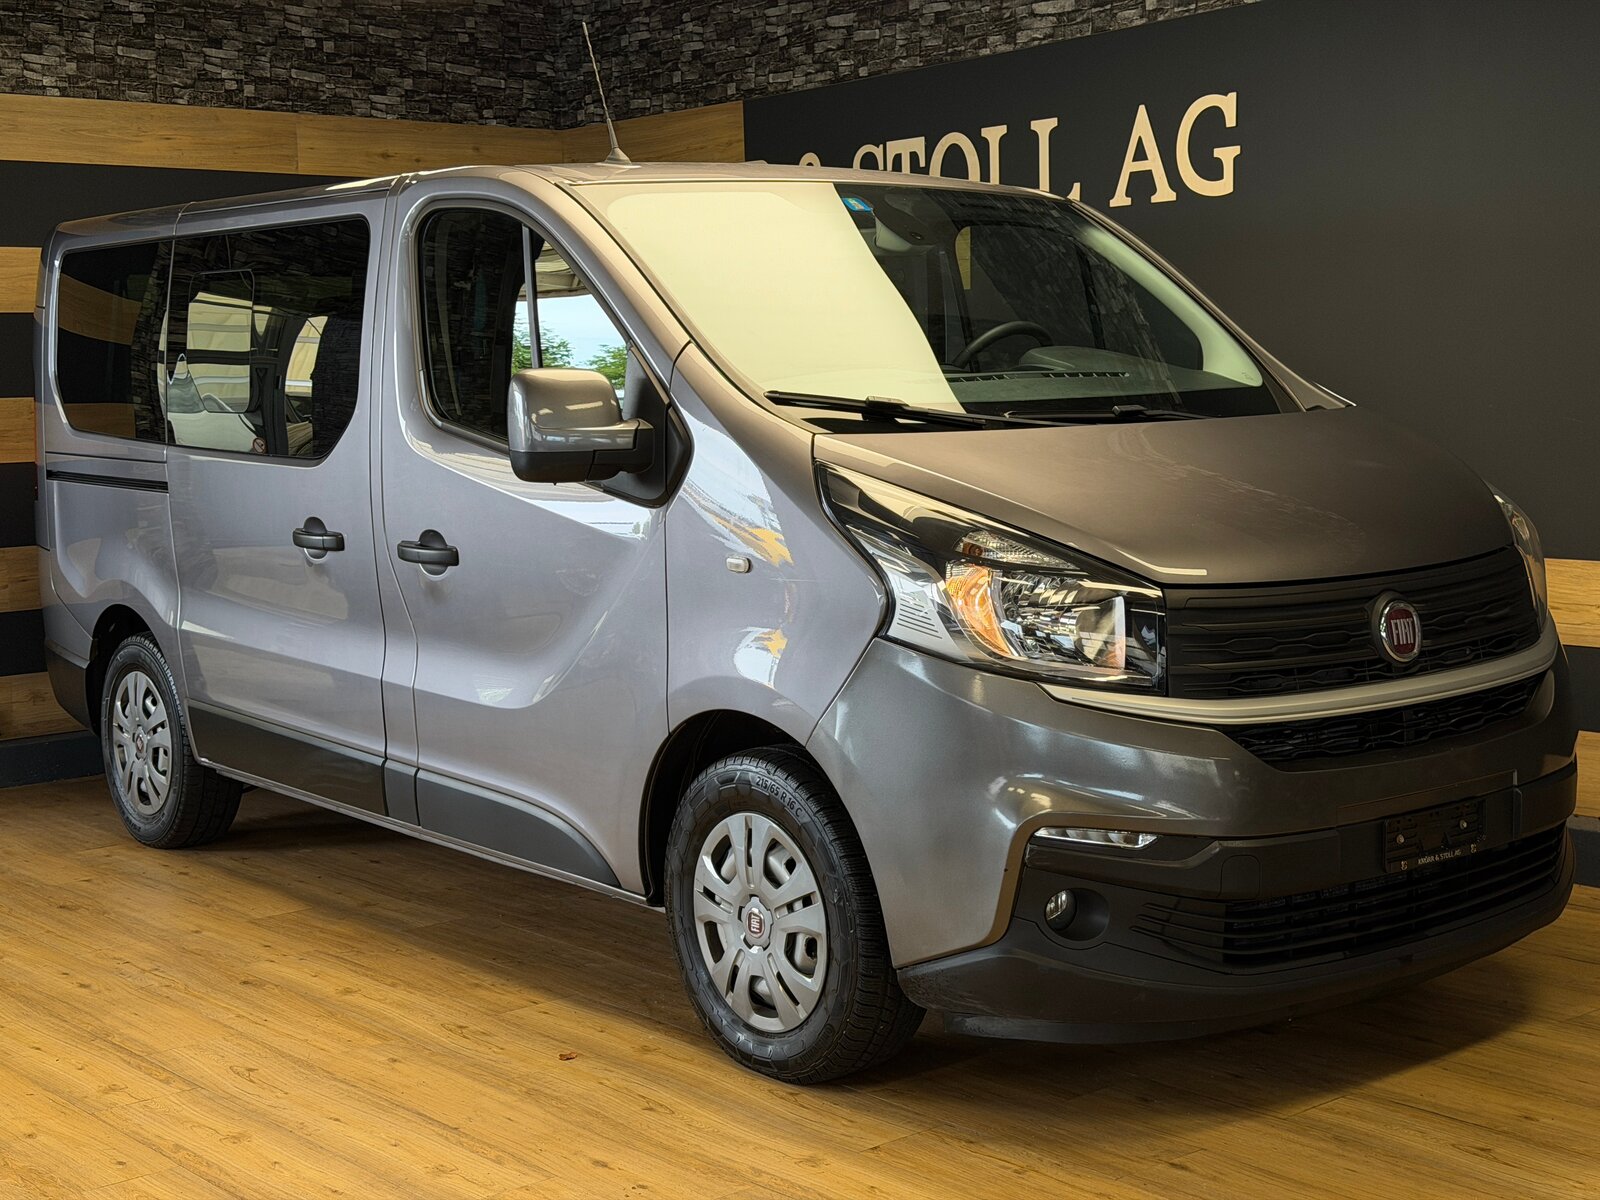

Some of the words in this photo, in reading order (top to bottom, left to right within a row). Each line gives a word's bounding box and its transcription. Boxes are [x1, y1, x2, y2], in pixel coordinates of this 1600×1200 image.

[1109, 91, 1241, 207] AG
[1390, 617, 1414, 646] FIAT
[755, 775, 781, 797] 215/65
[780, 791, 787, 803] R
[787, 798, 796, 810] 16
[795, 807, 803, 818] C
[1440, 850, 1454, 860] STOLL
[750, 914, 760, 933] FIAT
